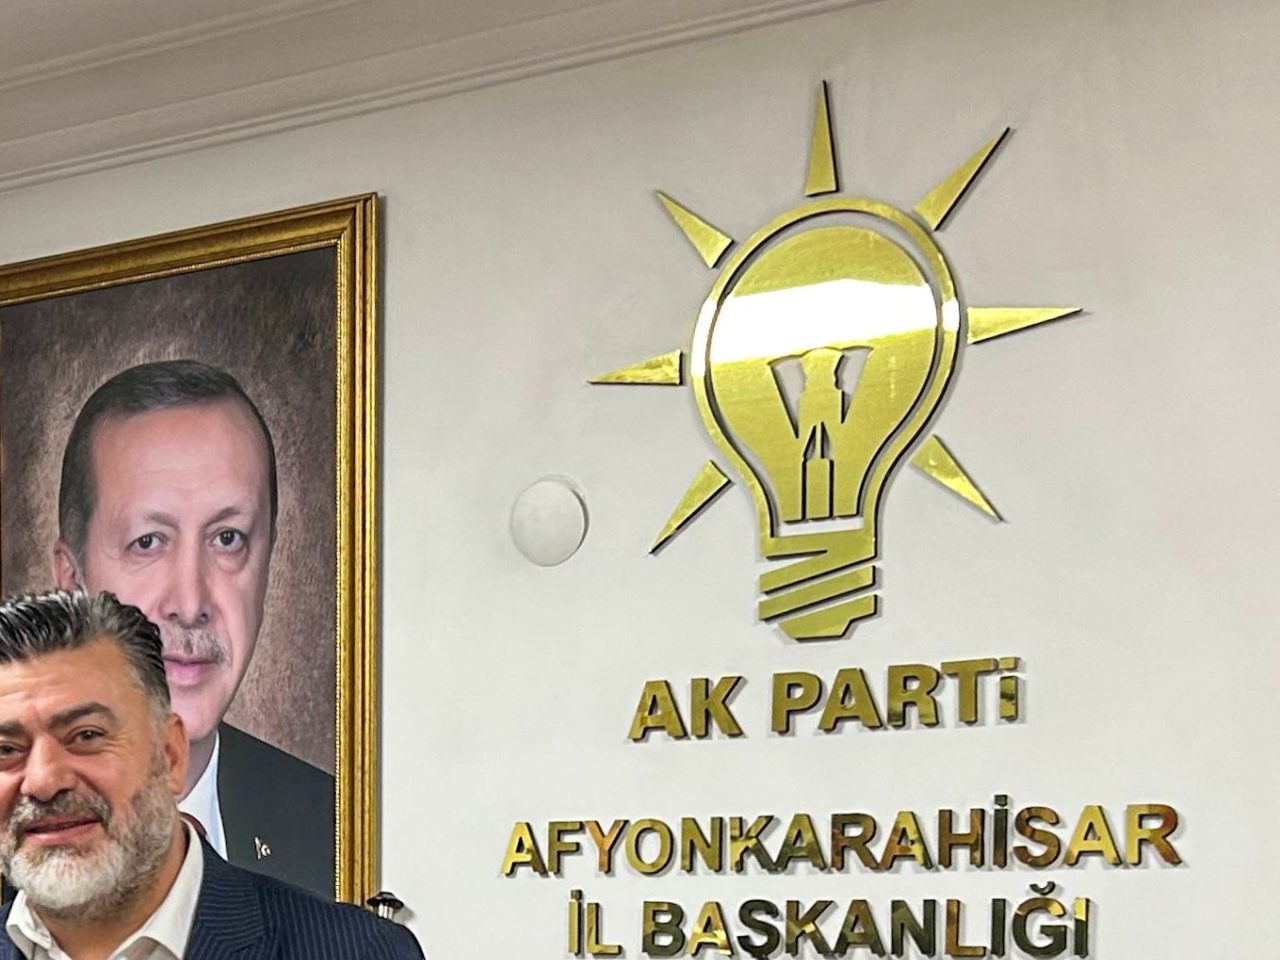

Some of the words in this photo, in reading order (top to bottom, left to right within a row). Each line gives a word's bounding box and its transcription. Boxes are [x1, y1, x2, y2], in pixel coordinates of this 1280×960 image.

[628, 676, 744, 742] AK
[501, 794, 1184, 877] AFYONKARAHİSAR
[568, 889, 622, 957] İL
